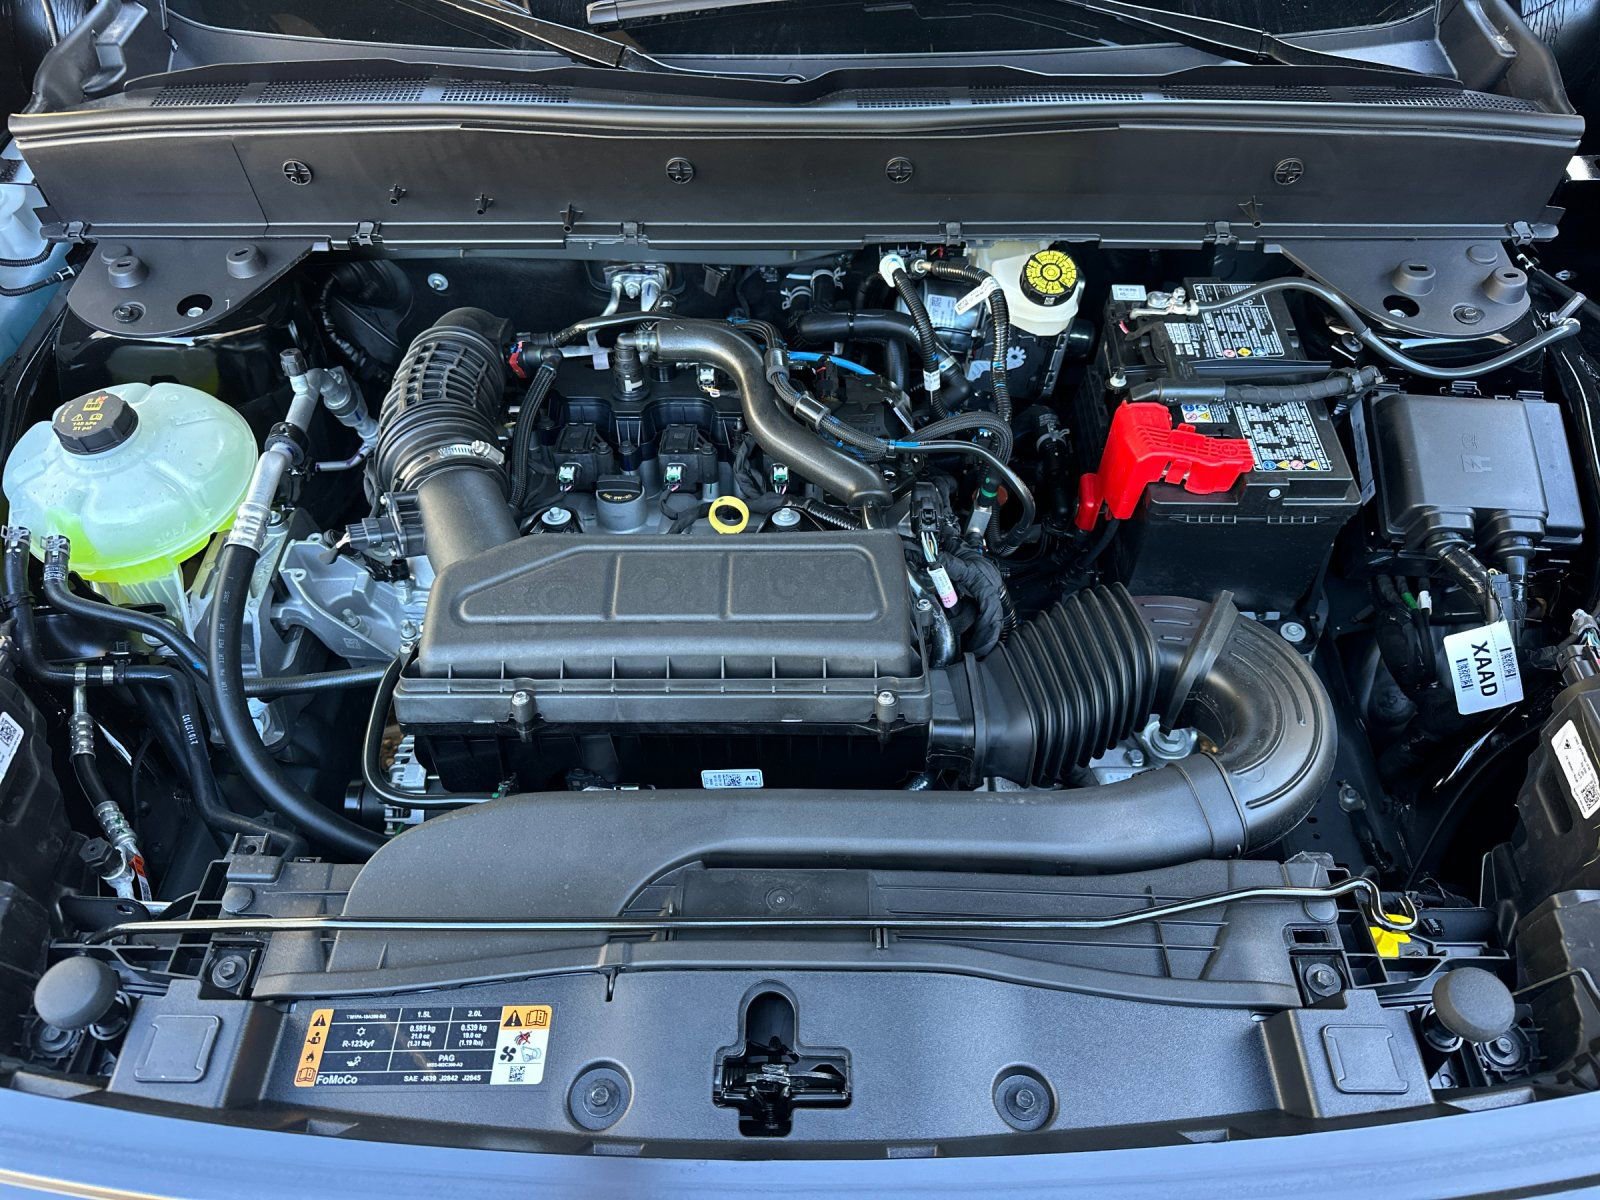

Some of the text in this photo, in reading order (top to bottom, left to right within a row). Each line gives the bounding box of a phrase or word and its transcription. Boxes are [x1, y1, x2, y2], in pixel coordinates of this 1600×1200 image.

[1471, 640, 1498, 697] XAAD
[427, 1024, 436, 1034] kg
[478, 1024, 487, 1033] kg
[341, 1039, 376, 1049] R-1234yf
[438, 1054, 456, 1062] PAG
[315, 1074, 359, 1085] FoMoCo
